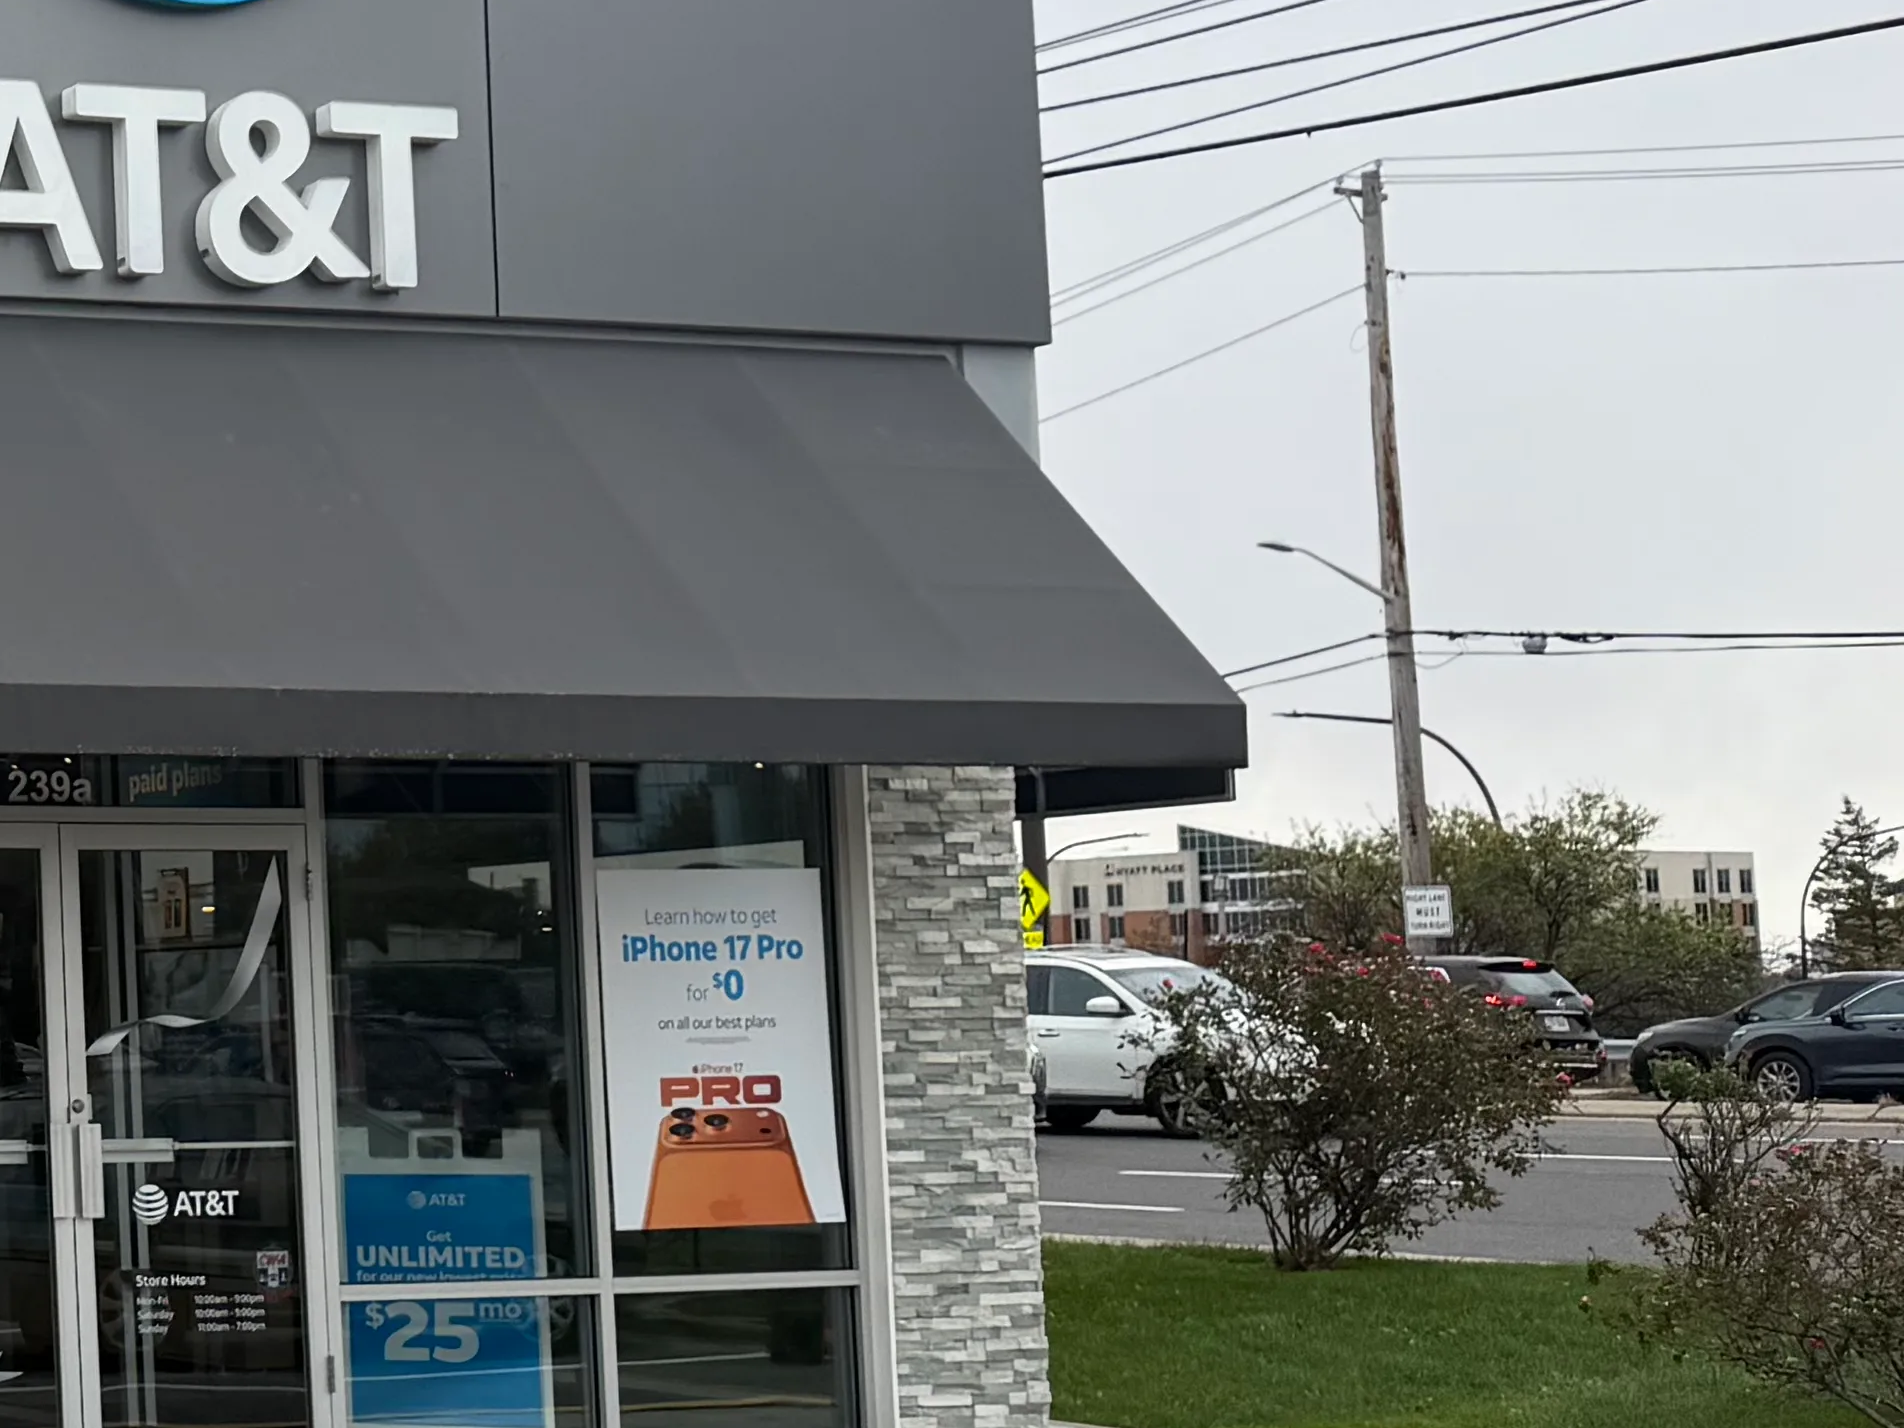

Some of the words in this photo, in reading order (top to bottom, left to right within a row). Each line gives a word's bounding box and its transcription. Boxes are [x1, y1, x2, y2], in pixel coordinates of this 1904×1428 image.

[8, 770, 92, 804] 239a
[129, 761, 168, 802] paid
[172, 760, 222, 797] plans
[1116, 865, 1147, 876] HYATT
[1151, 864, 1185, 874] PLACE
[645, 908, 690, 926] Learn
[693, 909, 727, 924] how
[731, 910, 747, 924] to
[751, 909, 777, 929] get
[1416, 906, 1440, 917] MUST
[622, 934, 717, 962] iPhone
[723, 935, 751, 960] 17
[757, 934, 803, 960] Pro
[687, 984, 709, 1001] for
[712, 969, 744, 1001] $0
[658, 1019, 674, 1030] on
[677, 1016, 690, 1029] all
[692, 1019, 712, 1029] our
[716, 1016, 742, 1029] best
[745, 1015, 776, 1031] plans
[699, 1064, 732, 1074] iPhone
[734, 1063, 743, 1073] 17
[660, 1075, 782, 1107] PRO
[173, 1190, 239, 1217] AT&T
[428, 1193, 466, 1206] AT&T
[426, 1230, 452, 1242] Get
[356, 1245, 525, 1268] UNLIMITED
[135, 1275, 169, 1287] Store
[170, 1274, 206, 1286] Hours
[356, 1270, 375, 1282] for
[379, 1272, 403, 1281] our
[406, 1272, 437, 1281] new
[137, 1309, 175, 1321] Saturday
[137, 1323, 169, 1335] Sunday
[365, 1301, 480, 1363] $25
[479, 1302, 522, 1320] mo
